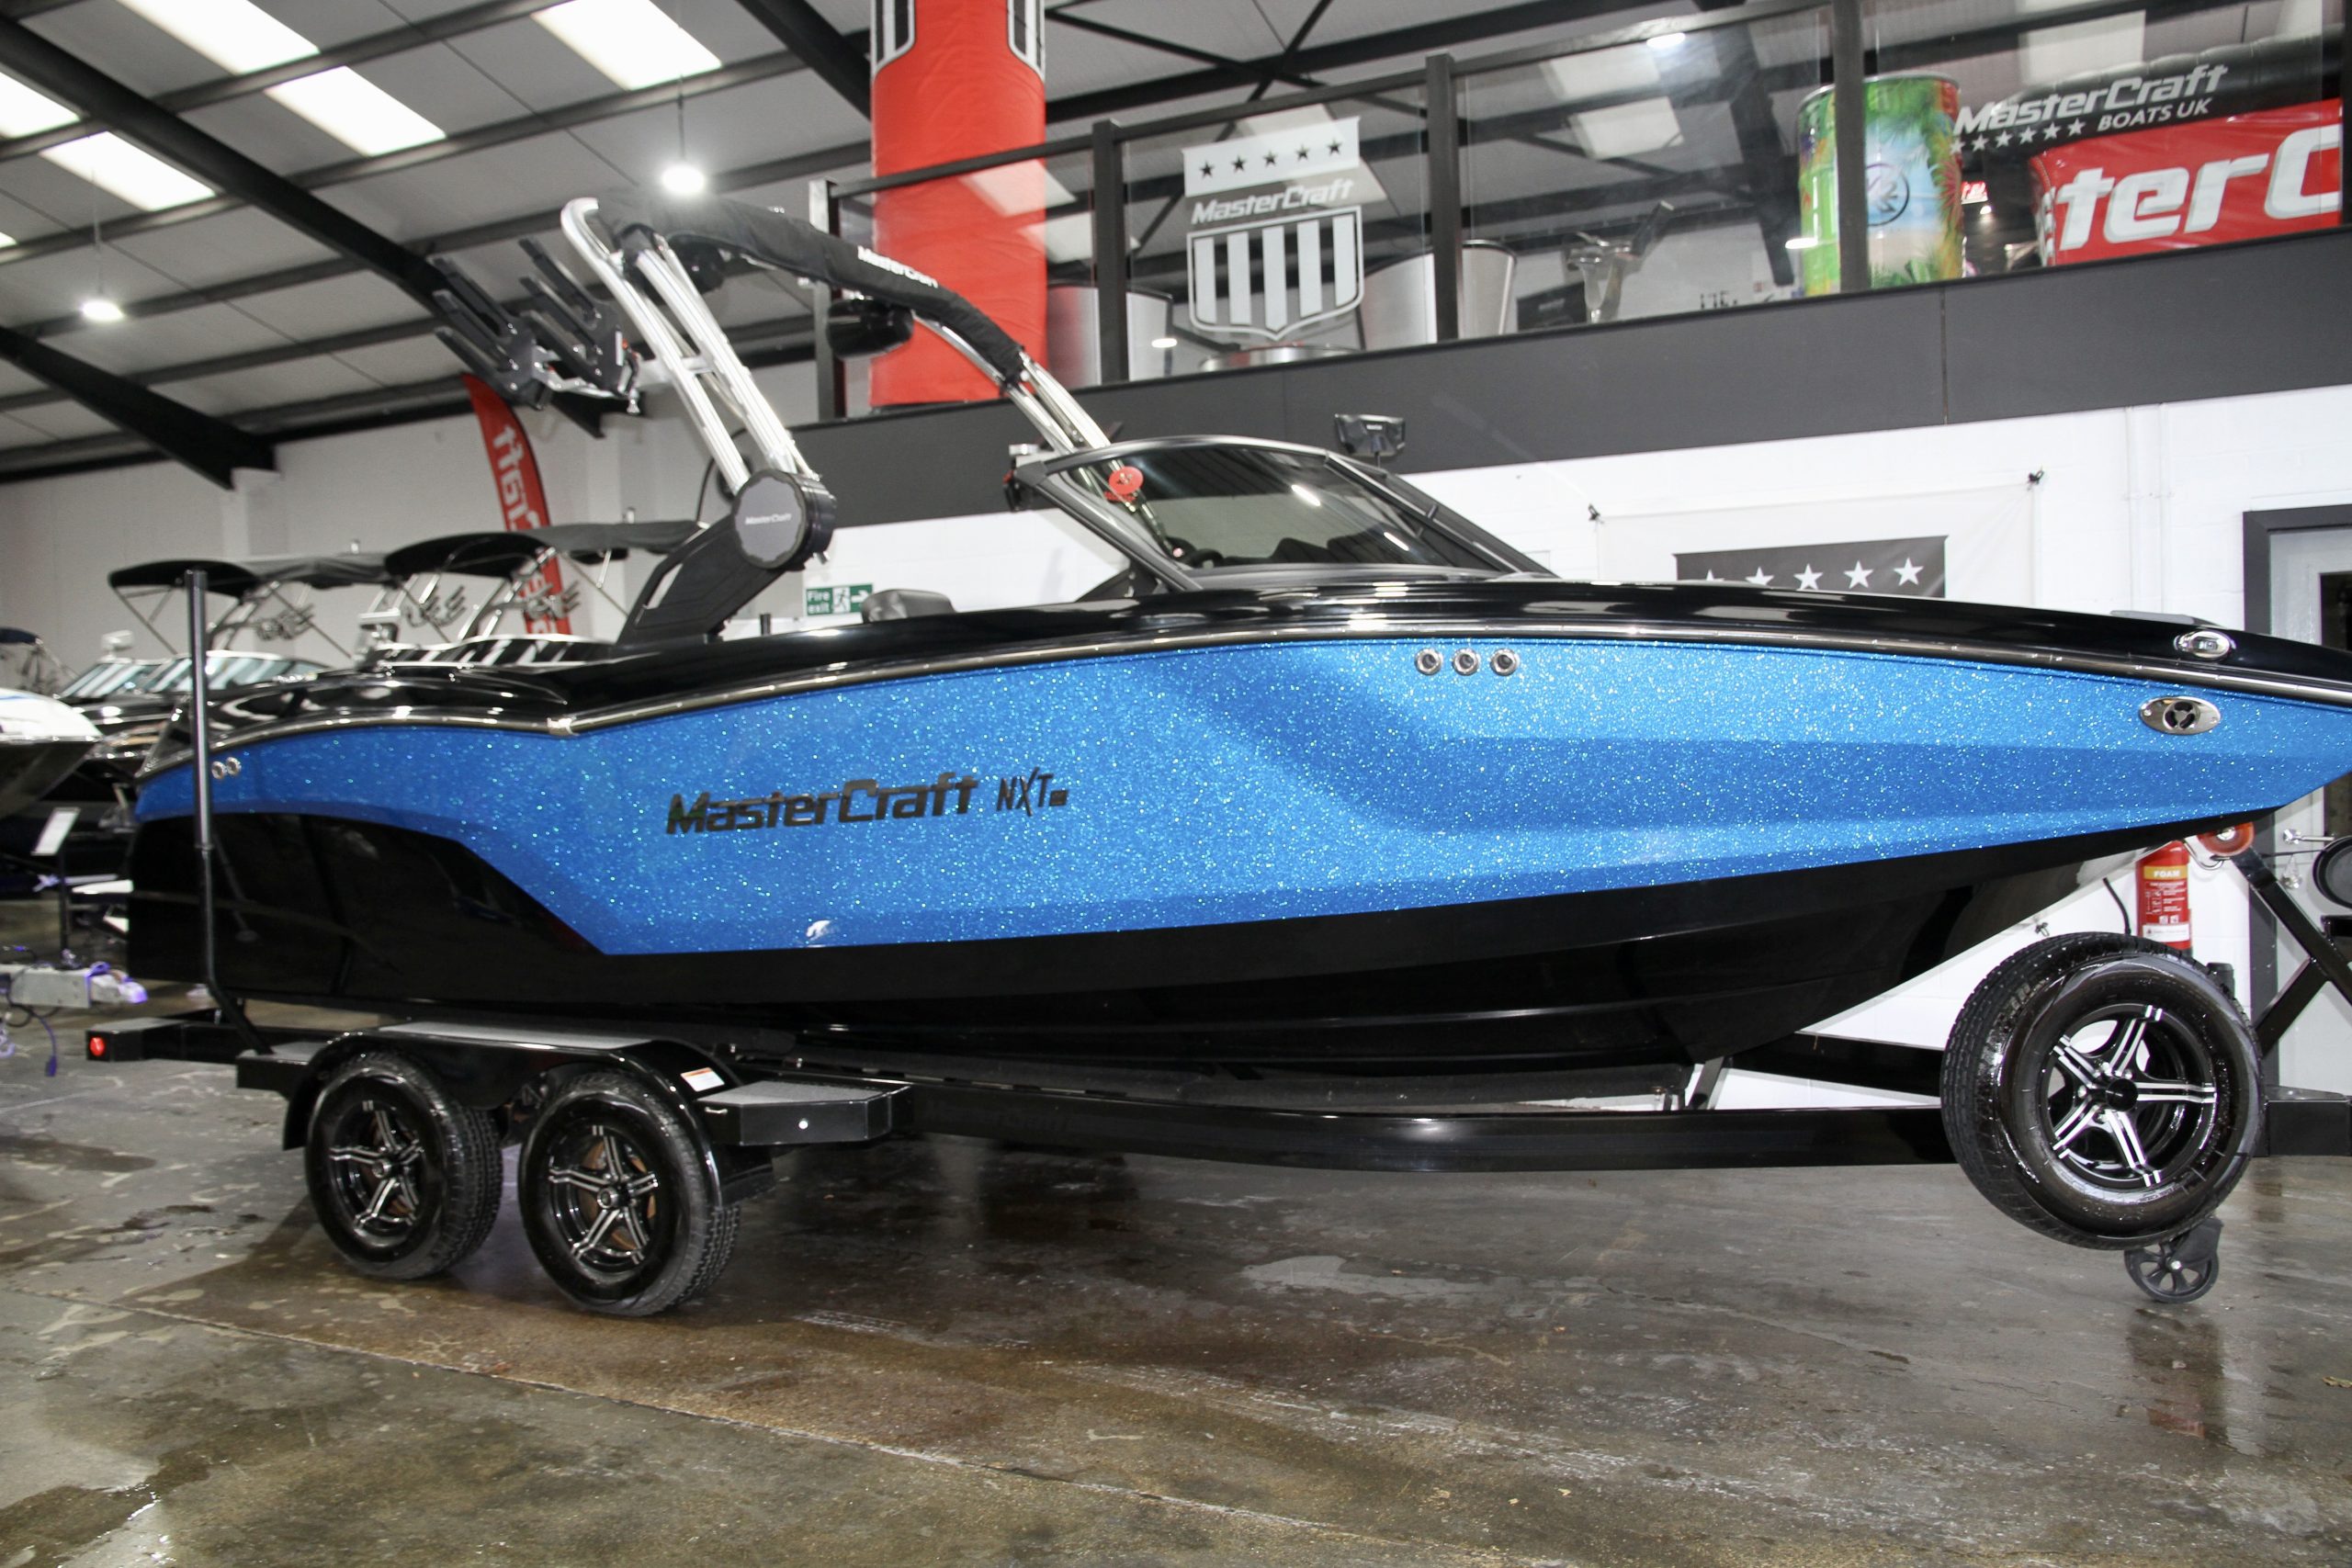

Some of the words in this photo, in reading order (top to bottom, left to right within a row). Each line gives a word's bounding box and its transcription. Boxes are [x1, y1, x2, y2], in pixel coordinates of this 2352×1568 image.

[1953, 64, 2228, 136] MasterCraft
[2097, 103, 2172, 132] BOATS
[2176, 96, 2213, 118] UK
[1192, 177, 1354, 225] MasterCraft
[808, 591, 831, 602] Fire
[808, 603, 831, 614] exit
[665, 772, 978, 834] MasterCraft
[996, 766, 1054, 817] NXT
[2154, 870, 2180, 878] FOAM
